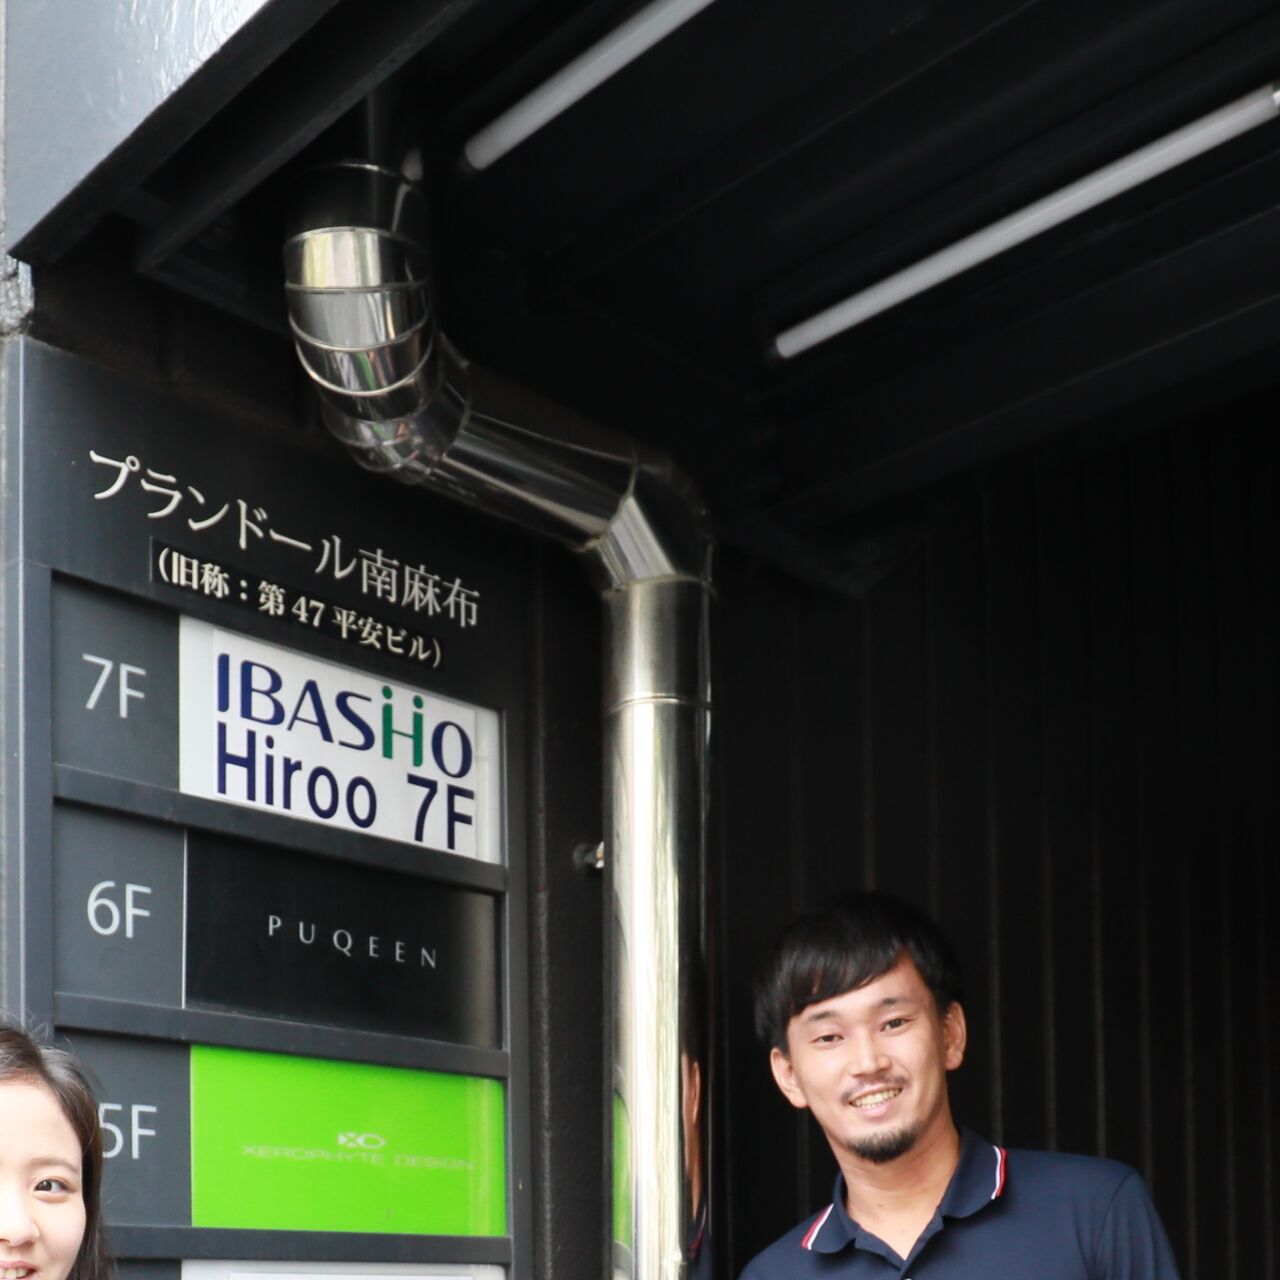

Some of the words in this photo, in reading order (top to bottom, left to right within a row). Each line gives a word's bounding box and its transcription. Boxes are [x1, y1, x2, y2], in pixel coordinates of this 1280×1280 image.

[82, 653, 148, 719] 7F
[216, 652, 473, 779] IBASHO
[216, 721, 378, 829] Hiroo
[406, 773, 475, 850] 7F
[86, 880, 152, 939] 6F
[268, 914, 437, 970] PUQEEN
[98, 1102, 158, 1160] 5F
